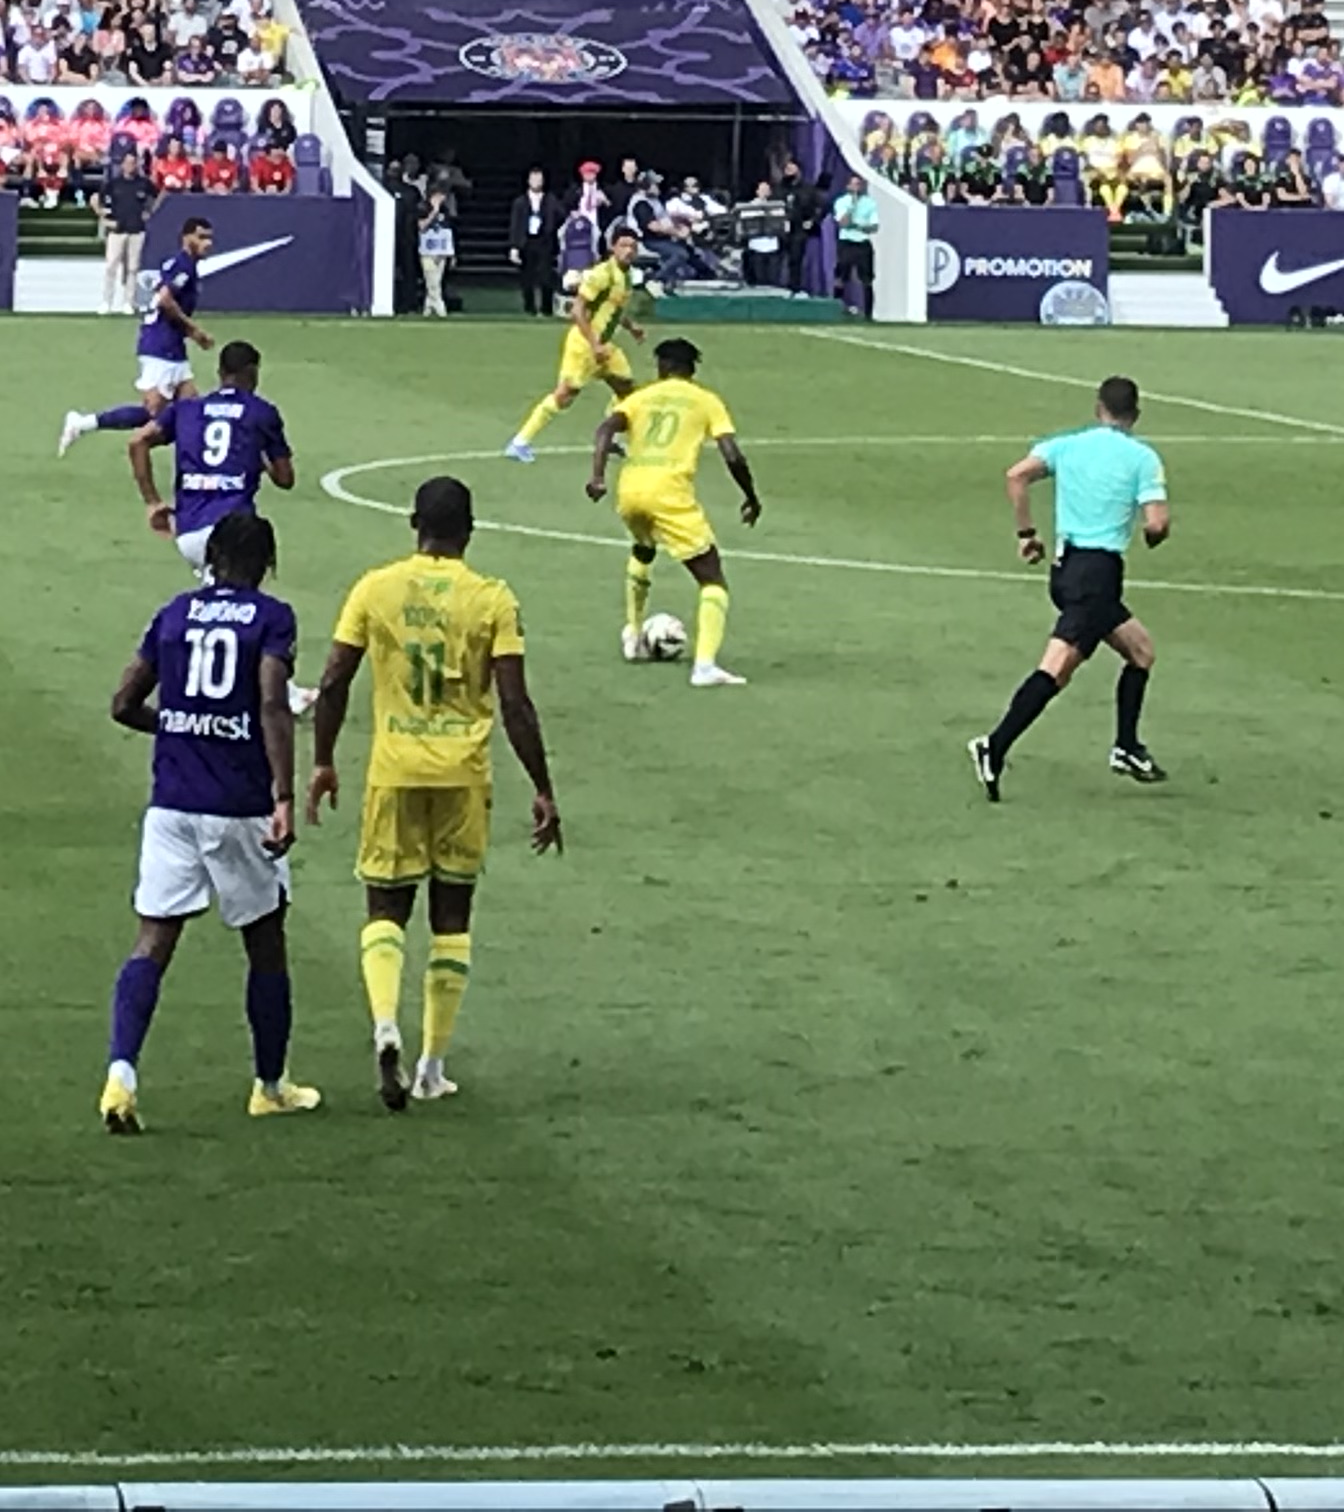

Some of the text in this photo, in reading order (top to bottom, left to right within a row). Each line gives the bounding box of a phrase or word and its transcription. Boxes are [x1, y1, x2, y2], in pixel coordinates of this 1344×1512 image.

[964, 257, 1093, 279] PROMOTION
[202, 419, 232, 467] 9
[185, 627, 238, 700] 10
[404, 641, 445, 707] 11
